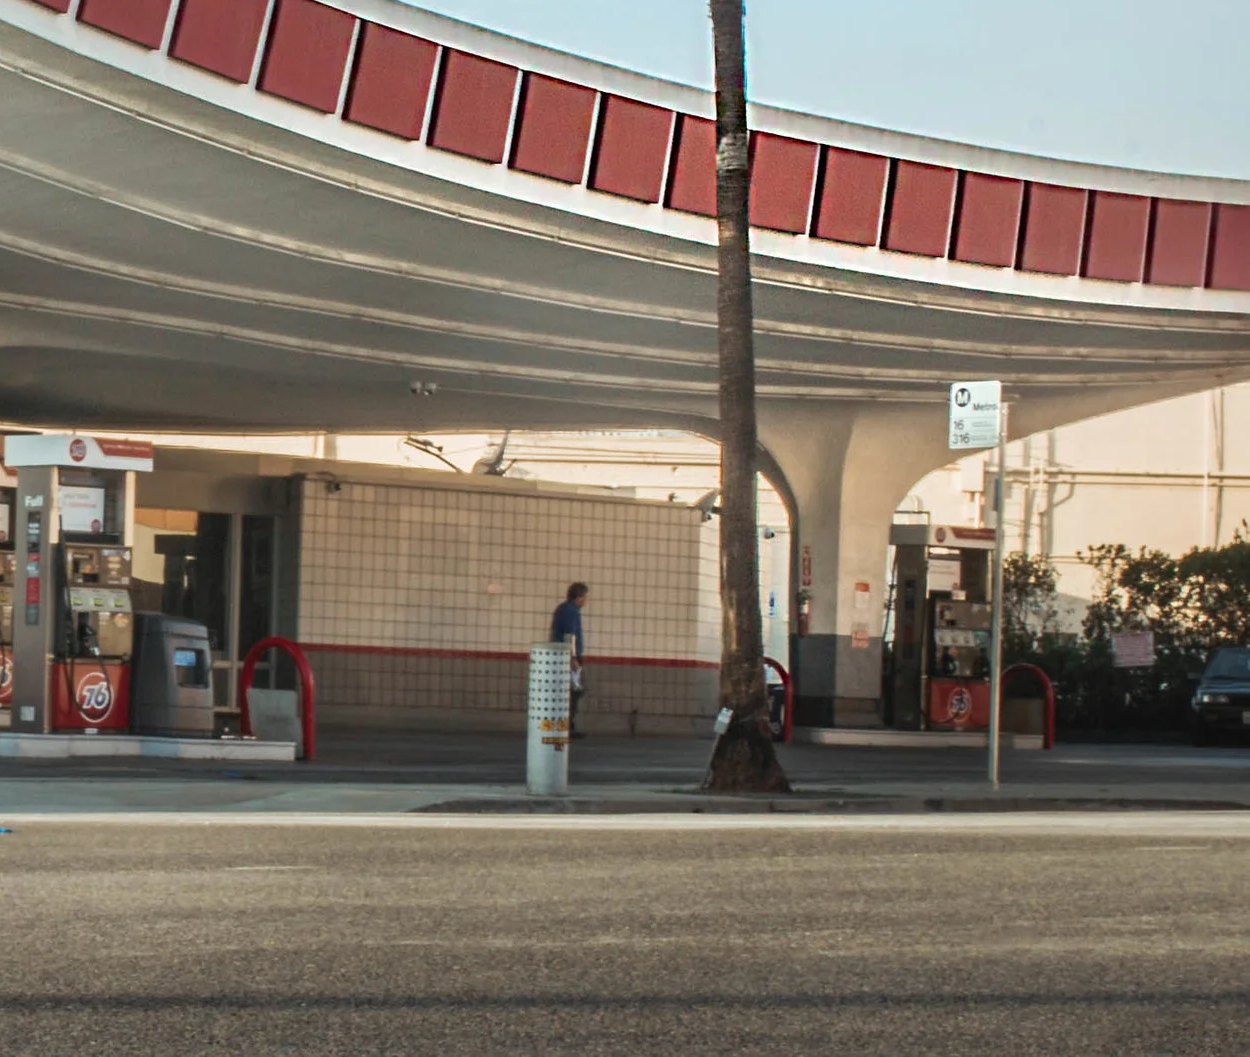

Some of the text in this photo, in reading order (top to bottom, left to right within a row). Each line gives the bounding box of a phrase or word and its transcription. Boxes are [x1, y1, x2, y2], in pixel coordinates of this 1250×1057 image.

[953, 419, 964, 431] 16
[952, 433, 970, 444] 316
[24, 495, 44, 507] Full
[82, 681, 109, 709] 76
